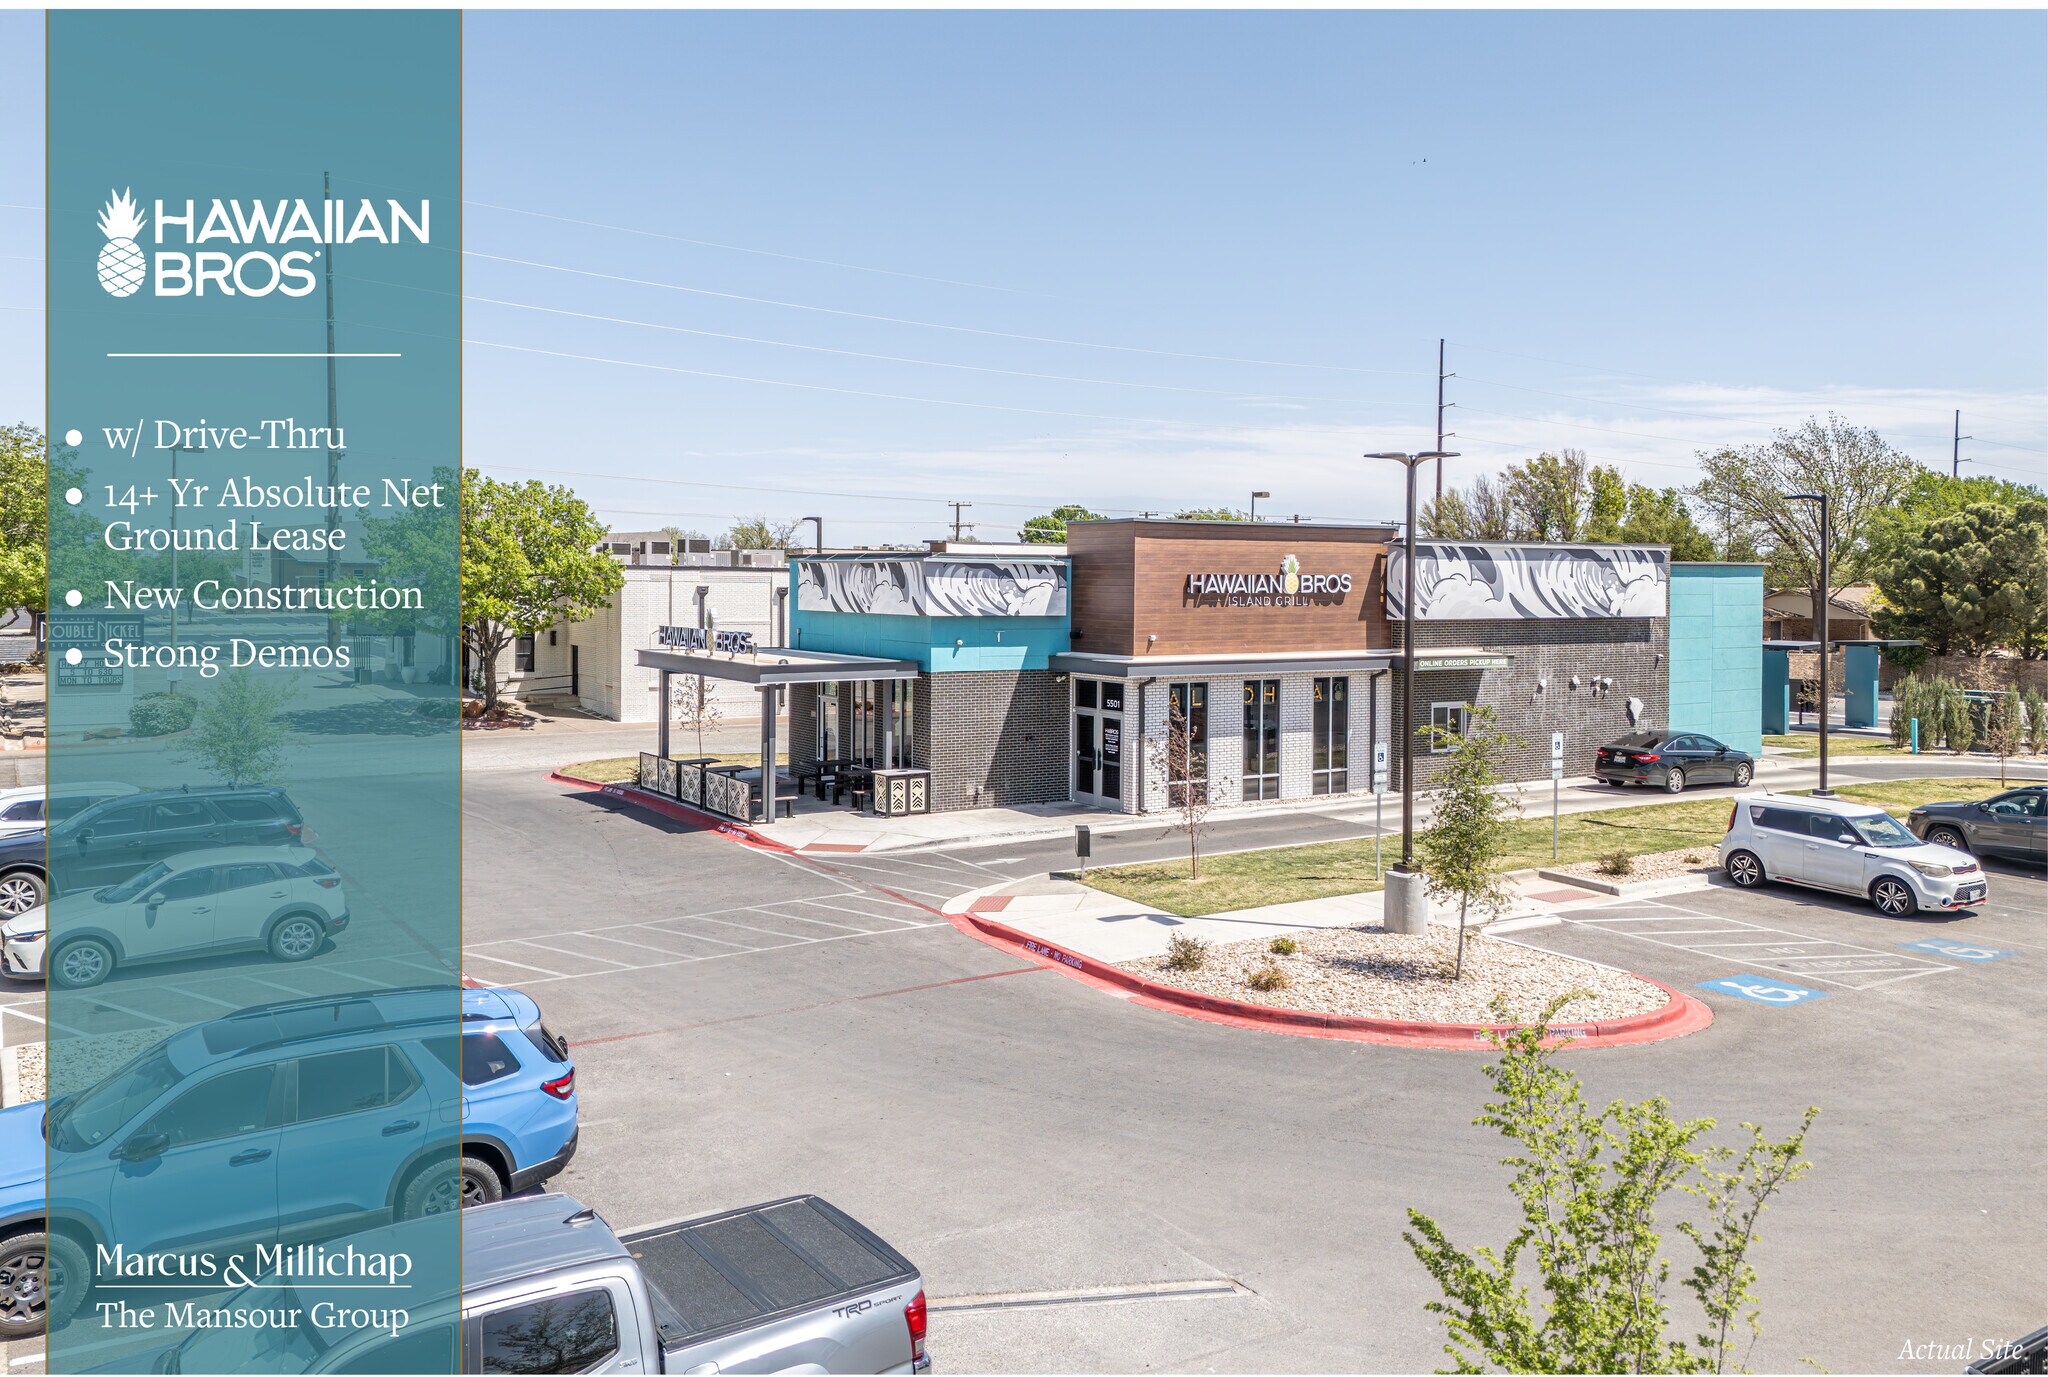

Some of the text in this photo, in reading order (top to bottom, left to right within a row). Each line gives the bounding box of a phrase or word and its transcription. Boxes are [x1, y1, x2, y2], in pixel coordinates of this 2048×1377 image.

[1190, 573, 1352, 594] HAWAIIAN BROS
[1228, 595, 1308, 606] ISLAND GRILL
[40, 621, 141, 643] DOUBLE NICKEL
[659, 625, 753, 655] HAWAIIAN BROS
[1420, 659, 1443, 667] ONLINE
[1444, 659, 1468, 667] ORDERS
[1469, 658, 1490, 666] PICKUP
[98, 676, 122, 684] THURS
[1106, 699, 1120, 708] 5501
[1037, 945, 1050, 957] LANE
[1061, 954, 1083, 969] PARKING
[1549, 1026, 1587, 1039] PARKING
[832, 1295, 903, 1319] TRD SPORT
